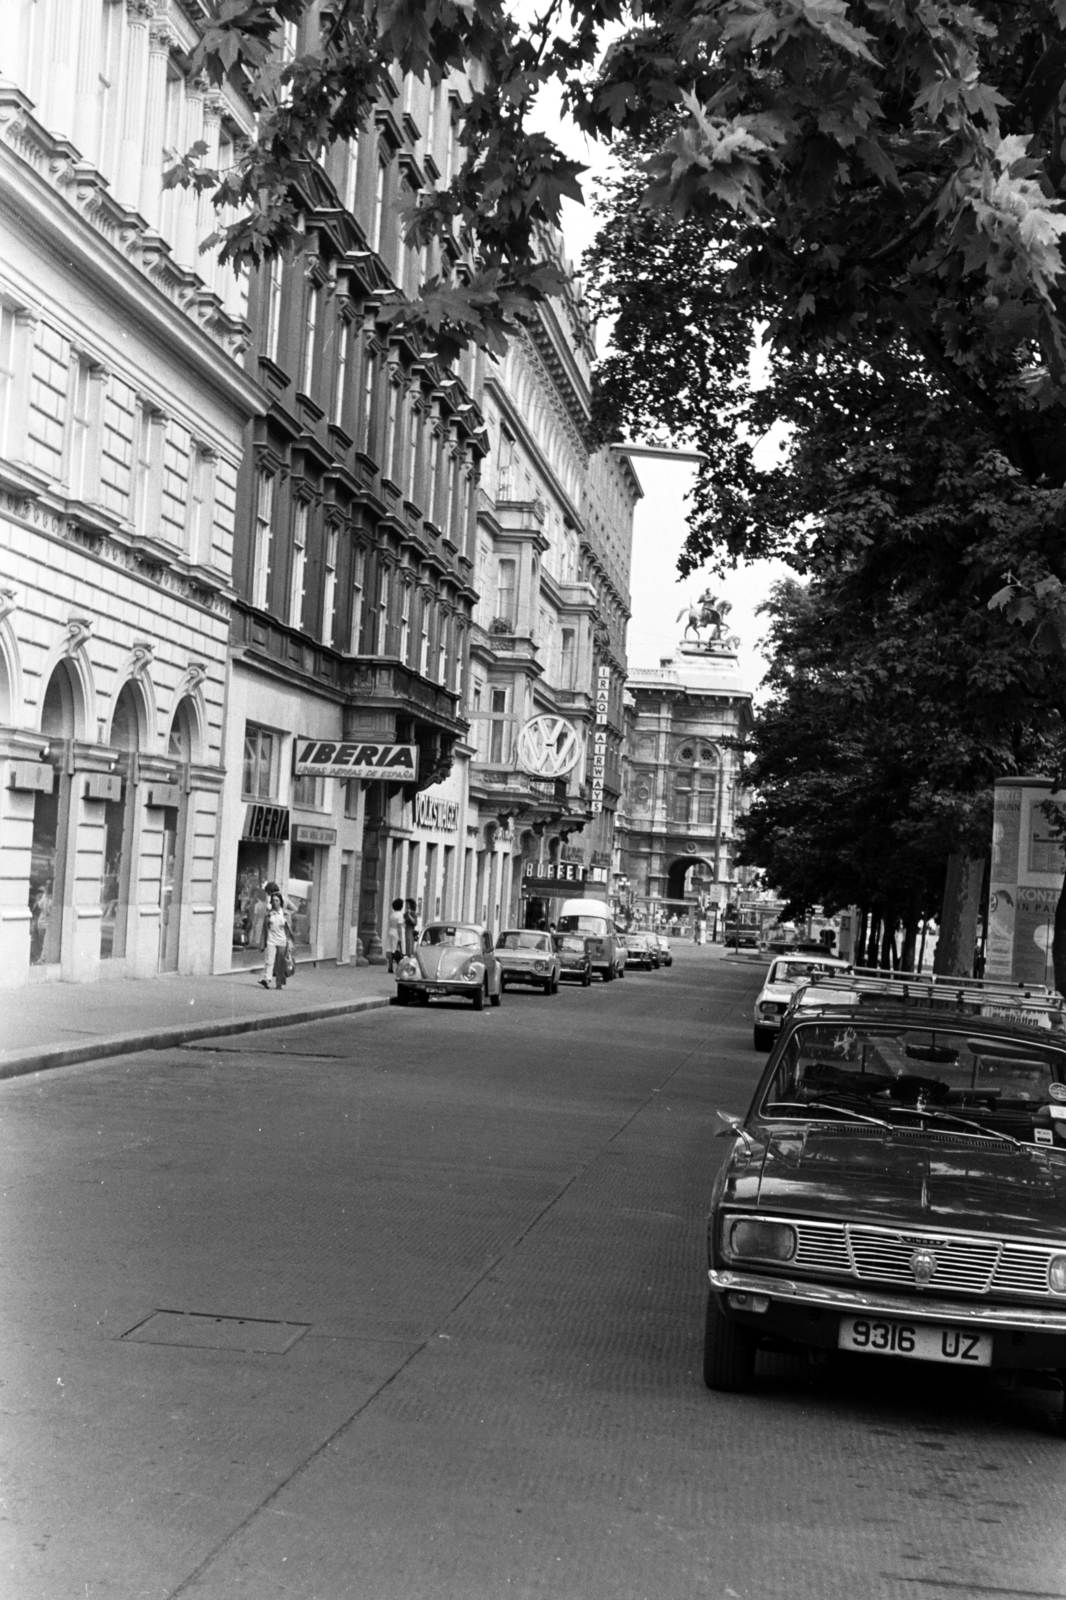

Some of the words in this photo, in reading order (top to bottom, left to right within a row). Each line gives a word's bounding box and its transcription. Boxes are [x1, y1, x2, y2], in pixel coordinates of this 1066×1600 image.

[597, 667, 609, 723] IRAQI
[298, 742, 414, 769] IBERIA
[366, 770, 378, 778] DE
[593, 734, 605, 811] AIRWAYS
[248, 805, 290, 840] IBERIA
[526, 863, 585, 881] BUFFET
[1017, 903, 1029, 911] IN
[852, 1321, 916, 1352] 9316
[941, 1331, 981, 1361] UZ
